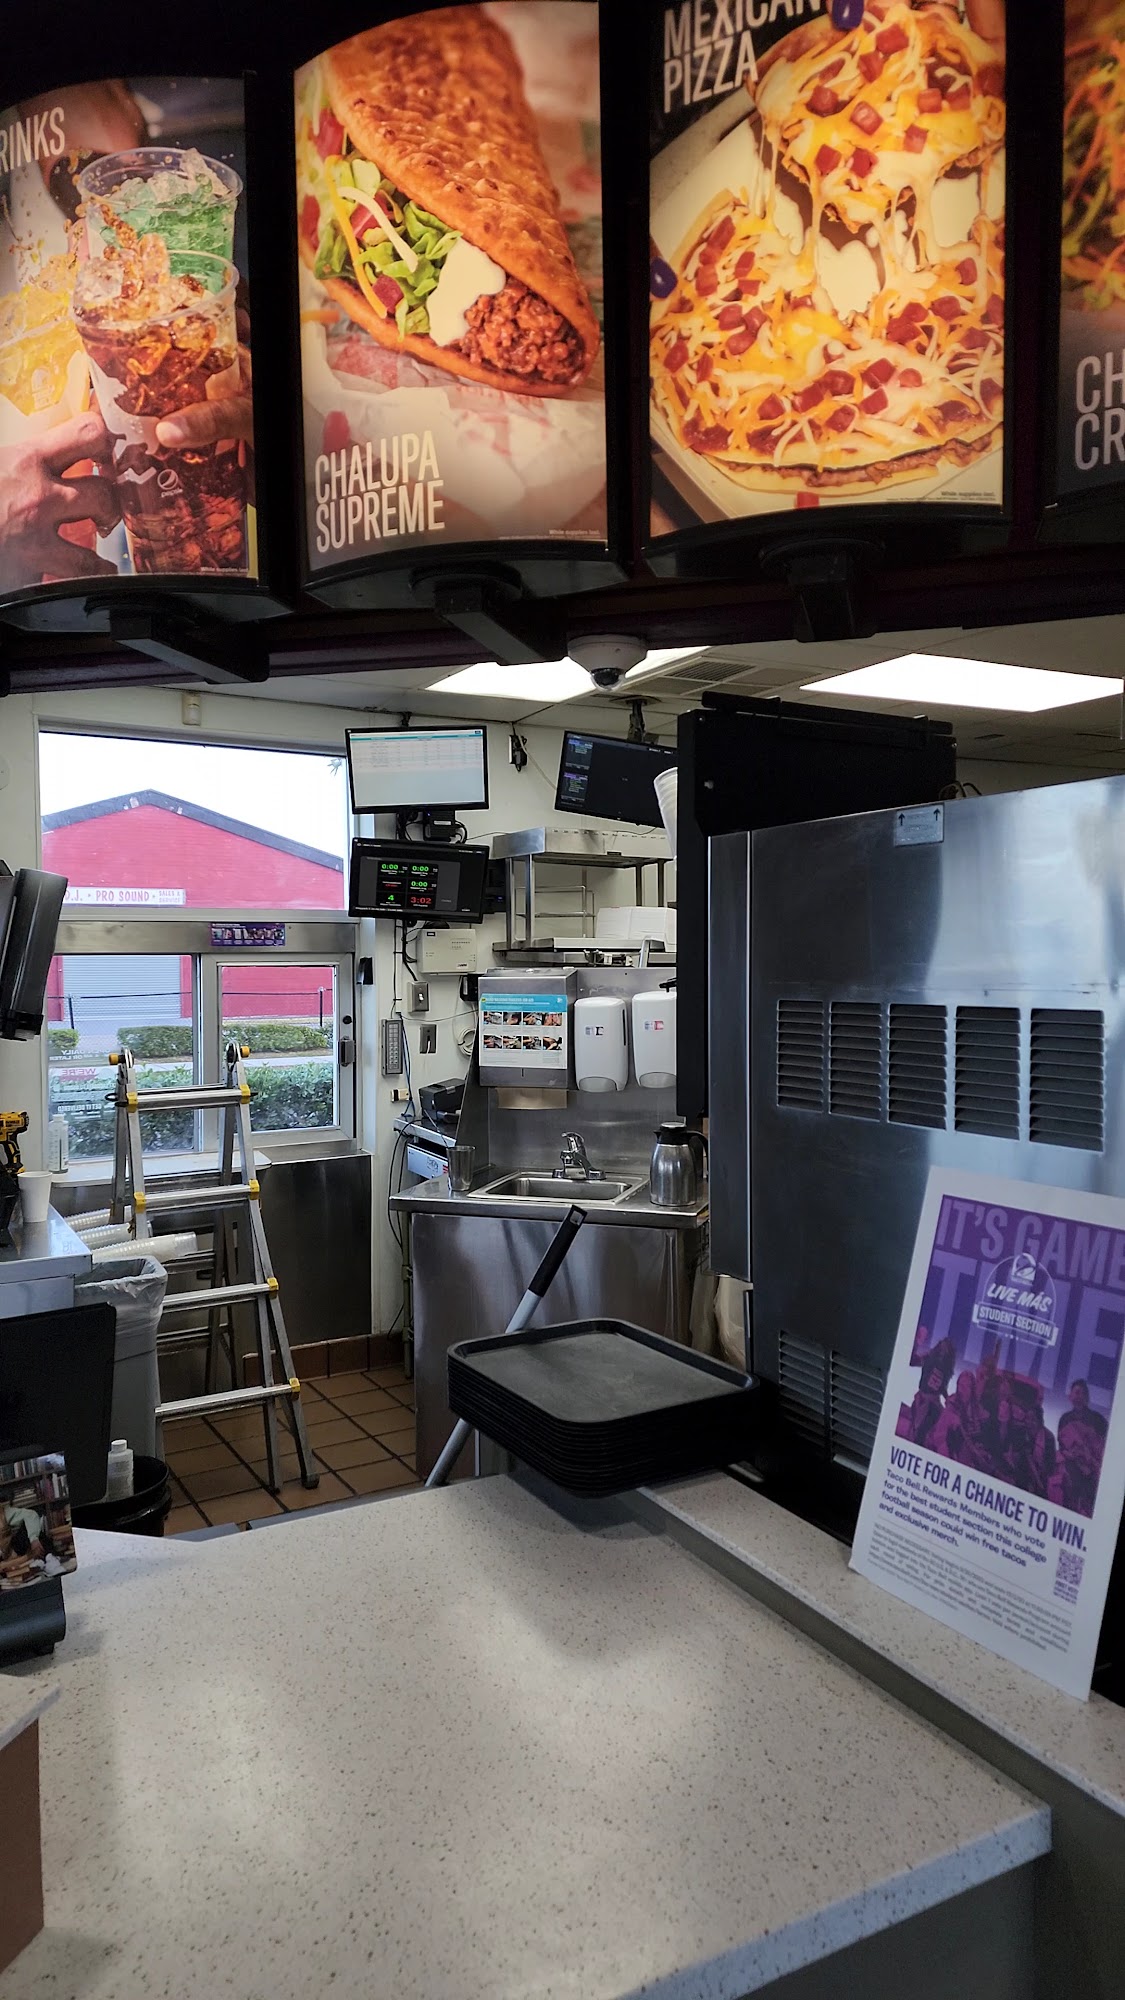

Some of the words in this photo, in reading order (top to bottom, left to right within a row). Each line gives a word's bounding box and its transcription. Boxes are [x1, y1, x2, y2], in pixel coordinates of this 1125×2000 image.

[664, 0, 821, 60] MEXIC
[664, 31, 759, 113] PIZZA
[315, 430, 440, 504] CHALUPA
[316, 479, 445, 553] SUPREME
[96, 890, 114, 902] PRO
[118, 890, 150, 902] SOUND
[410, 896, 432, 904] 3:02
[935, 1198, 1009, 1259] IT'S
[979, 1306, 1016, 1325] STUDENT
[1015, 1315, 1052, 1337] SECTION
[987, 1282, 1019, 1303] LIVE
[1017, 1291, 1053, 1312] MÁS
[878, 1502, 894, 1514] and
[894, 1510, 930, 1532] exclusive
[931, 1528, 960, 1547] merch.
[881, 1490, 910, 1510] football
[911, 1506, 939, 1524] season
[940, 1520, 964, 1536] could
[965, 1532, 980, 1545] win
[982, 1539, 999, 1553] free
[1001, 1549, 1027, 1567] tacos
[884, 1480, 895, 1490] for
[896, 1486, 909, 1498] the
[910, 1492, 928, 1507] best
[929, 1502, 961, 1522] student
[962, 1518, 994, 1538] section
[995, 1533, 1012, 1547] this
[1014, 1543, 1047, 1563] college
[887, 1468, 904, 1483] Taco
[922, 1485, 958, 1508] Rewards
[959, 1503, 1001, 1528] Members
[1003, 1524, 1022, 1538] who
[1024, 1534, 1046, 1549] vote
[890, 1446, 922, 1476] VOTE
[923, 1461, 950, 1489] FOR
[951, 1474, 962, 1495] A
[965, 1479, 1025, 1523] CHANCE
[1028, 1506, 1048, 1533] TO
[1052, 1516, 1087, 1552] WIN.
